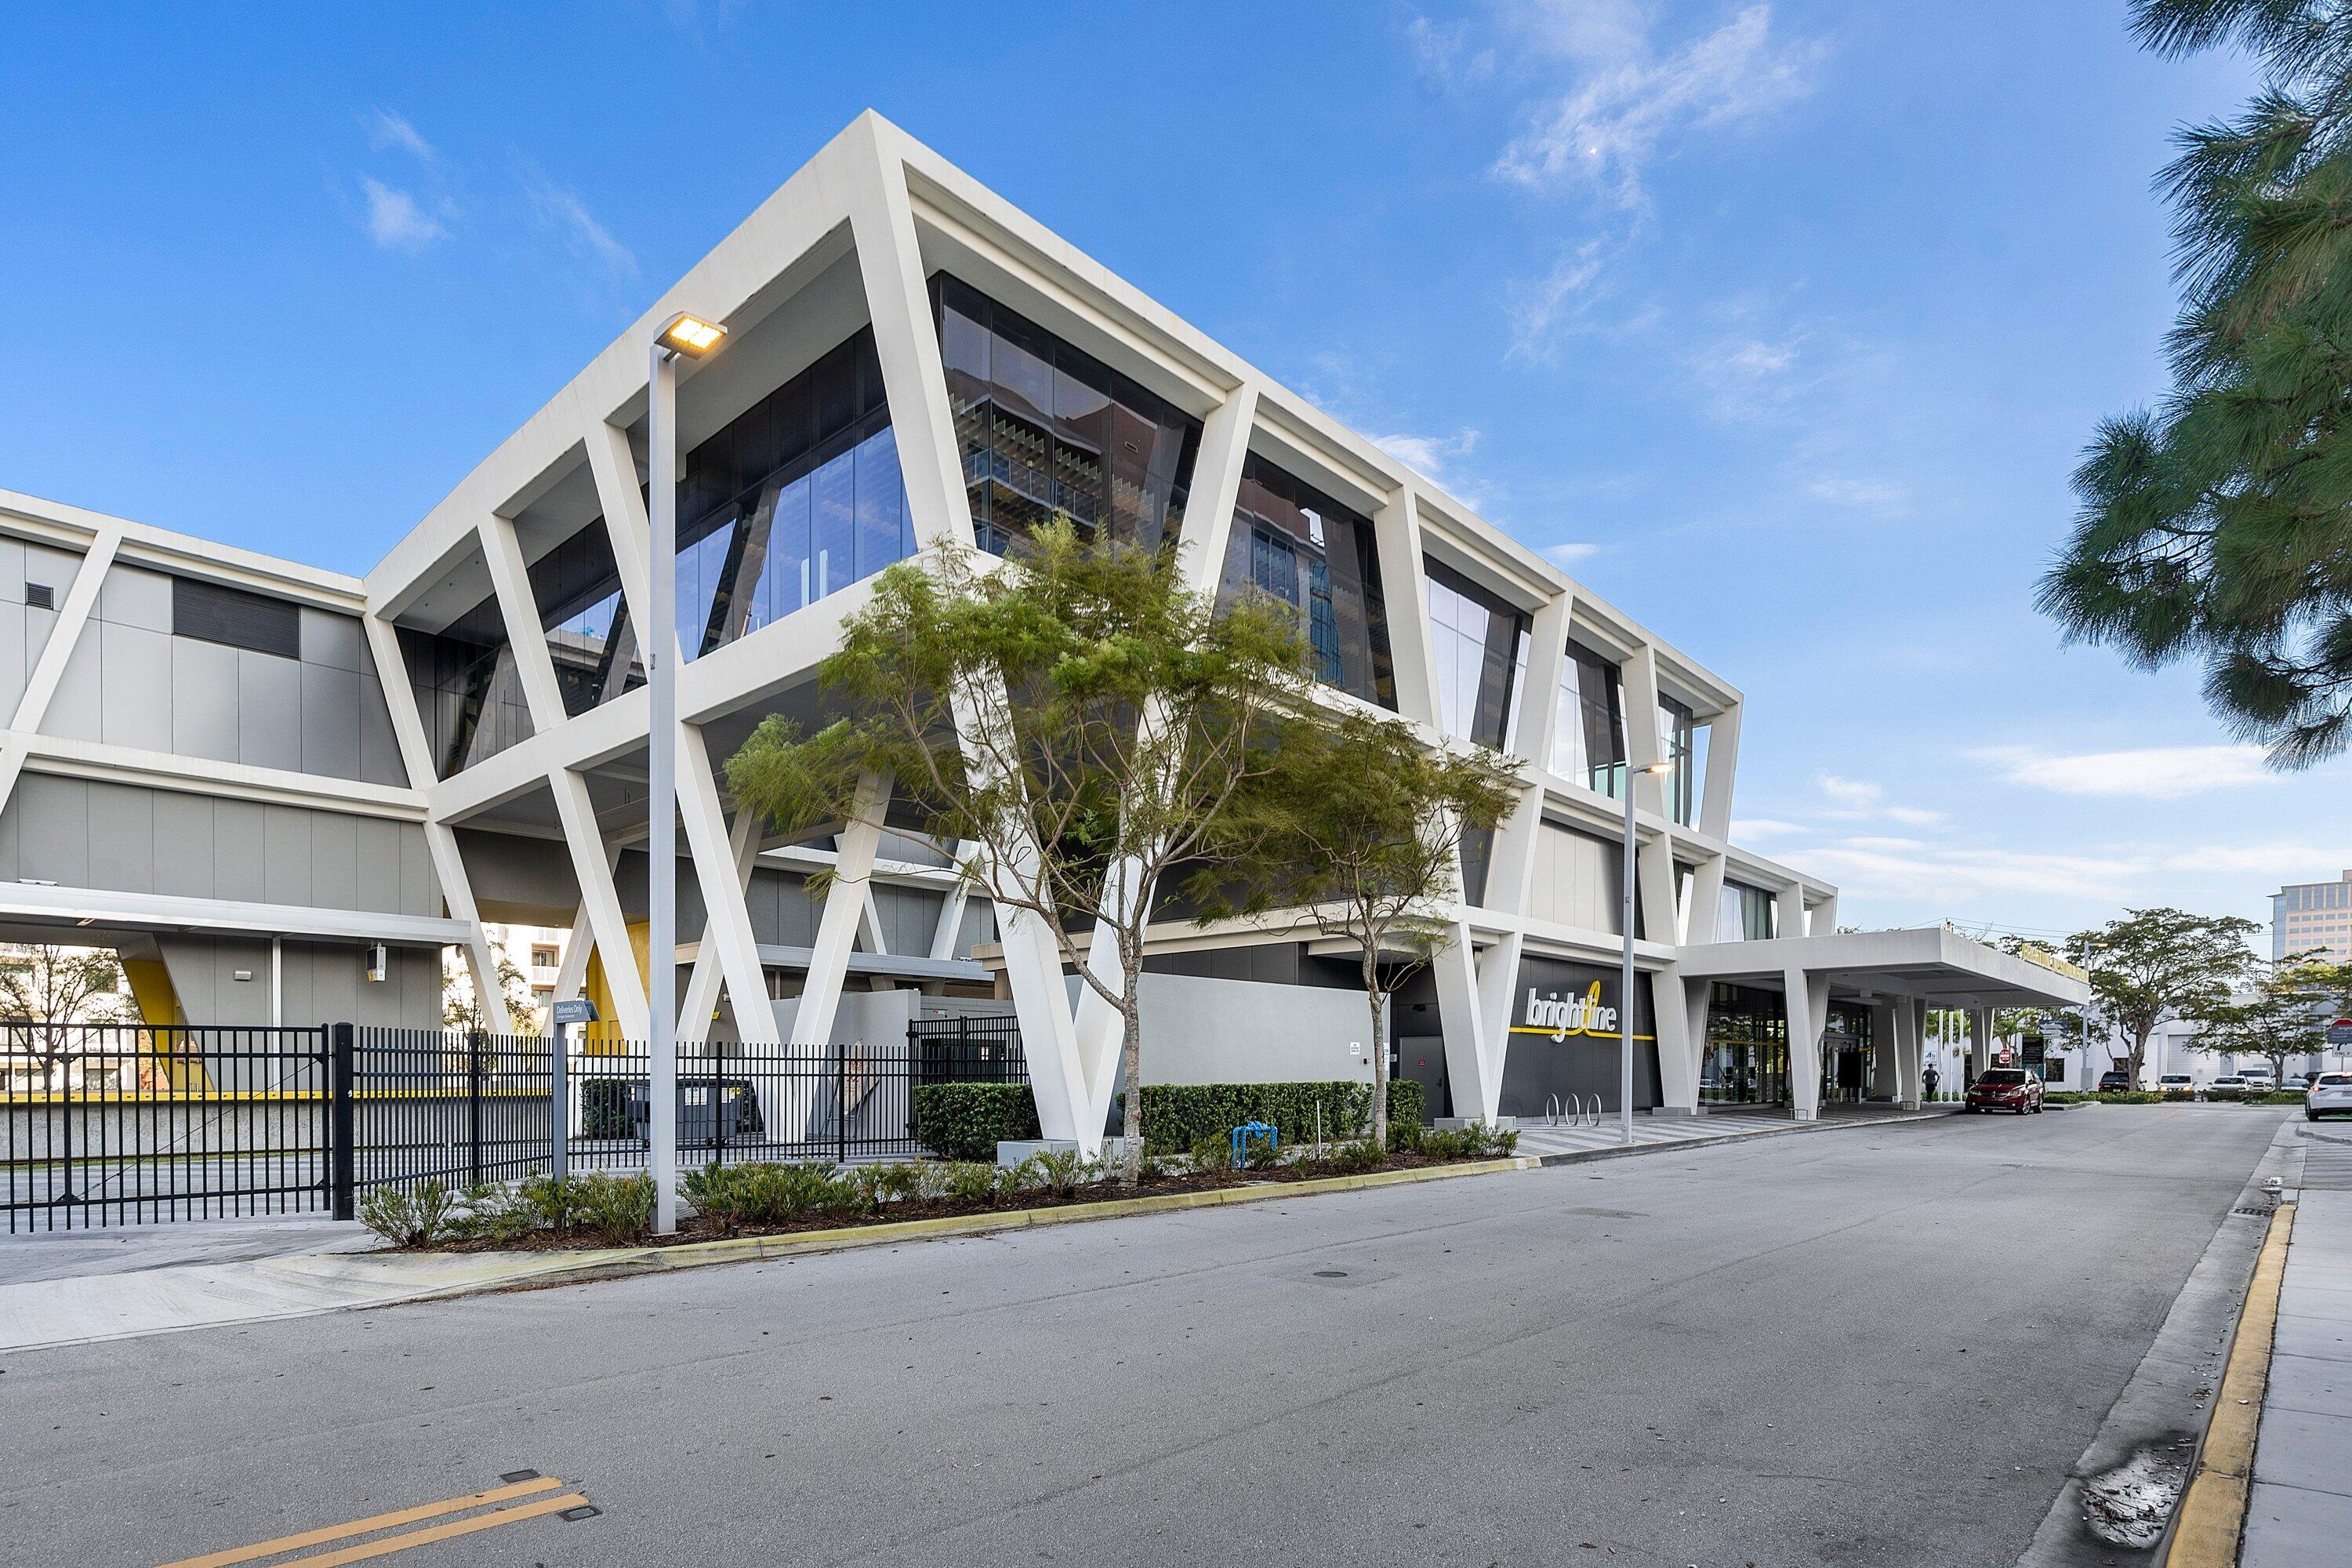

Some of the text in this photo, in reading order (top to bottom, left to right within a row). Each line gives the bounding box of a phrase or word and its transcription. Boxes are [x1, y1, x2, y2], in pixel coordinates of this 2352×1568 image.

[557, 1004, 583, 1014] Deliveries Only
[1526, 980, 1617, 1044] brightline
